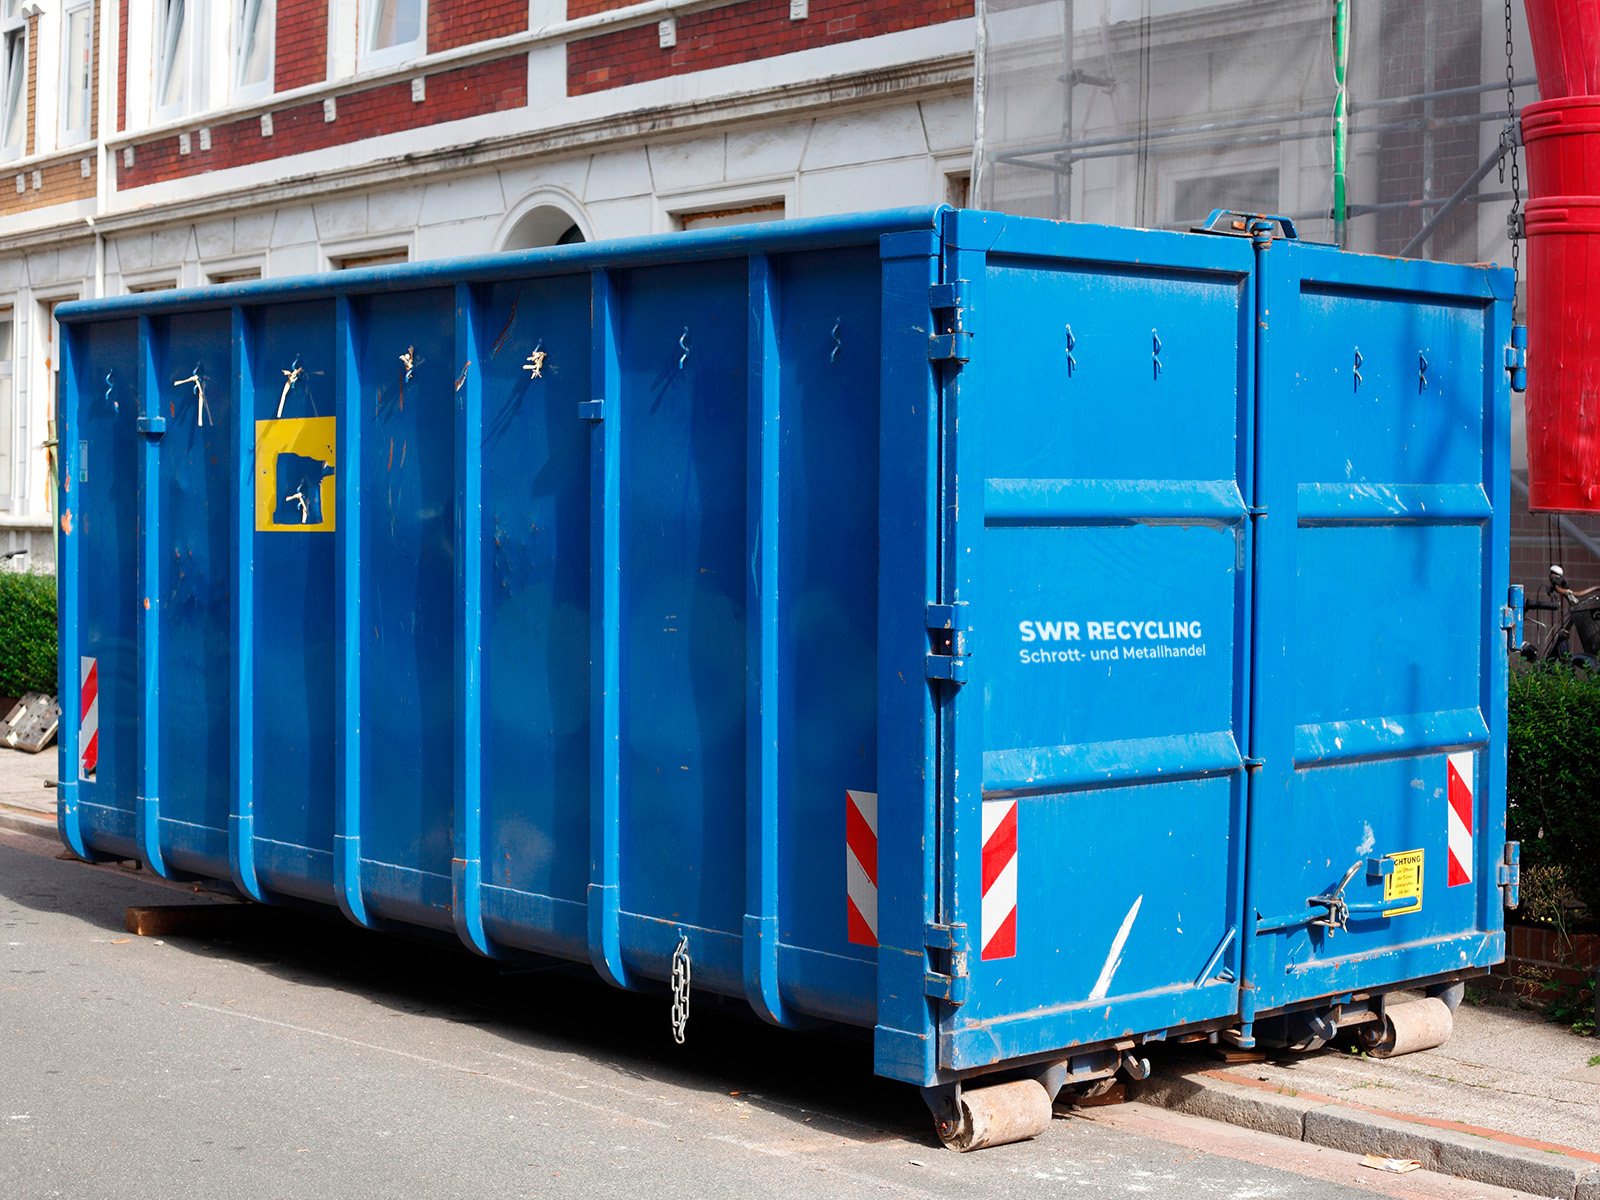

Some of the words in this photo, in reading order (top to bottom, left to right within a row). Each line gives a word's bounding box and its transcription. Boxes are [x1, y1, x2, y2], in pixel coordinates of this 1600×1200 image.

[1019, 620, 1081, 642] SWR
[1087, 620, 1202, 640] RECYCLING
[1019, 648, 1086, 664] Schrott-
[1090, 646, 1119, 661] und
[1122, 643, 1206, 660] Metallhandel
[1394, 855, 1420, 866] CHTUNG
